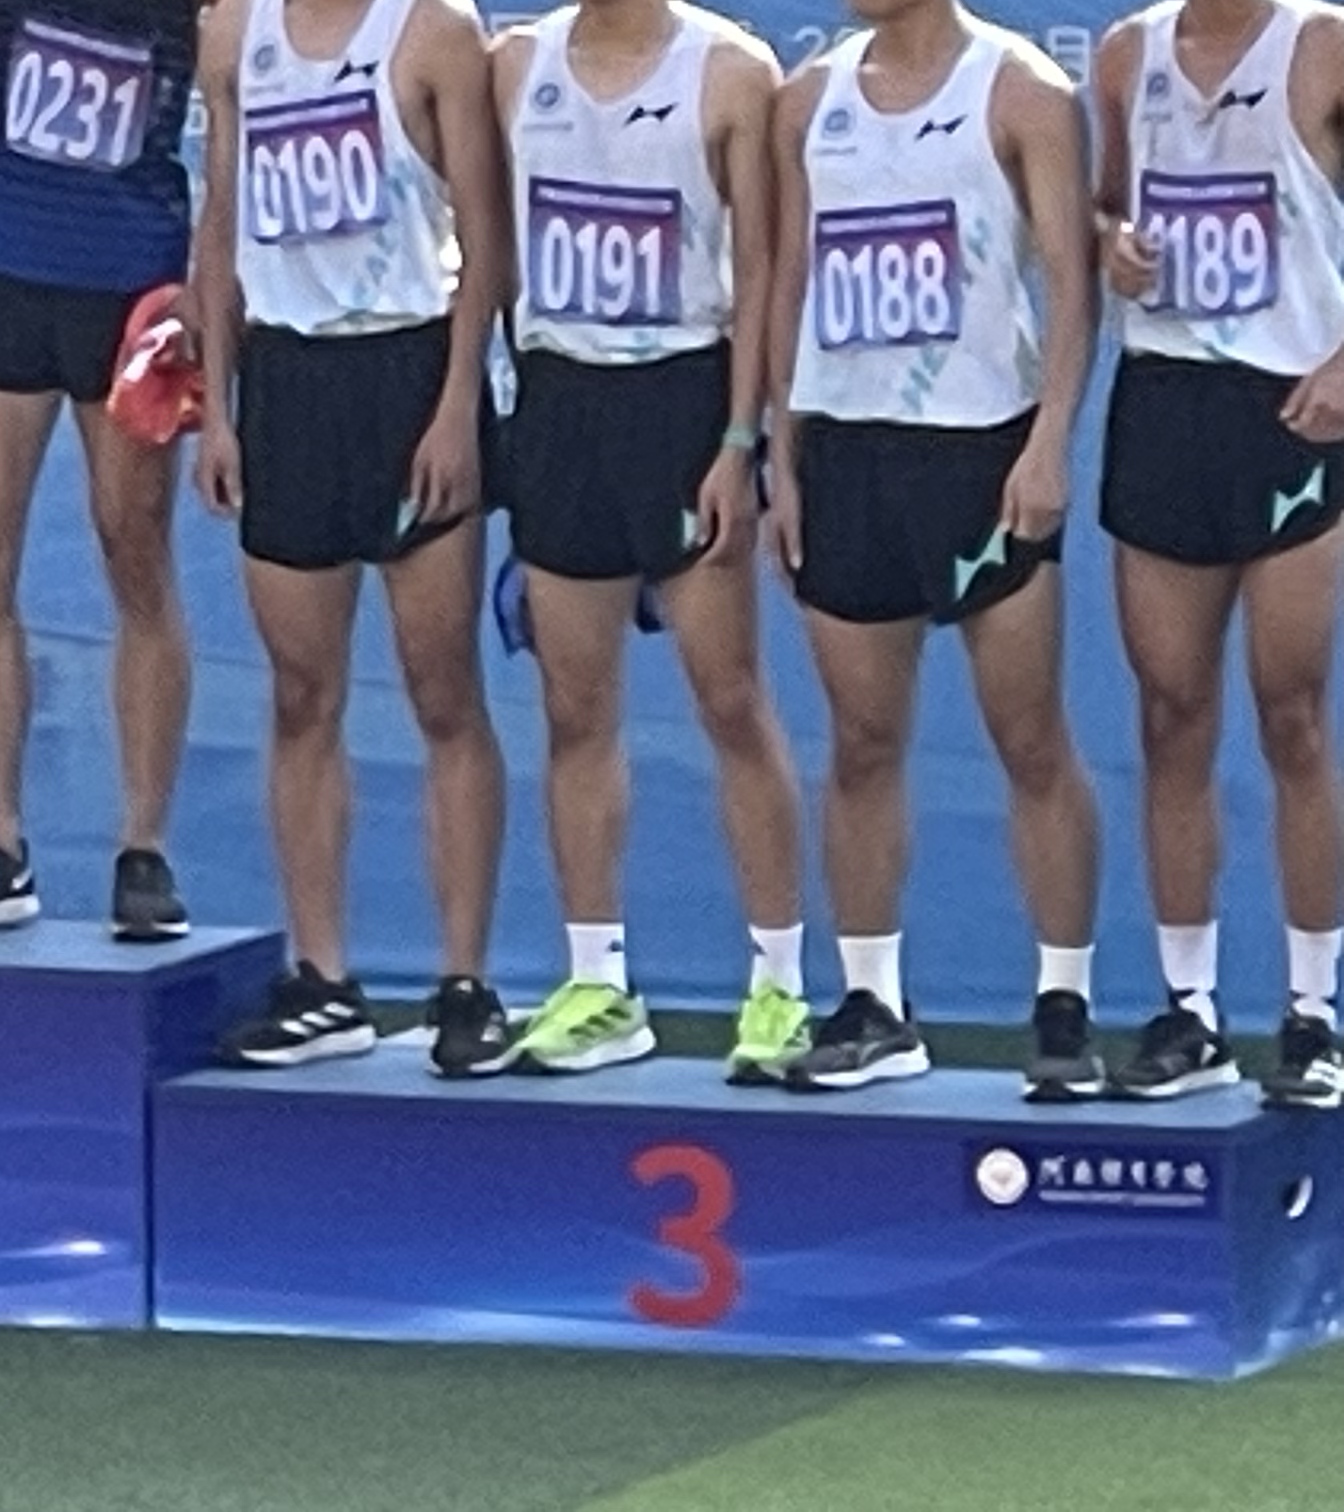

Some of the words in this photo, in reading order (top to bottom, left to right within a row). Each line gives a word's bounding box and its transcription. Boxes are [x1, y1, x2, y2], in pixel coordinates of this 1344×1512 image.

[6, 51, 141, 167] 0231
[253, 130, 379, 239] 0190
[541, 216, 662, 317] 0191
[823, 241, 951, 346] 0188
[627, 1143, 743, 1330] 3
